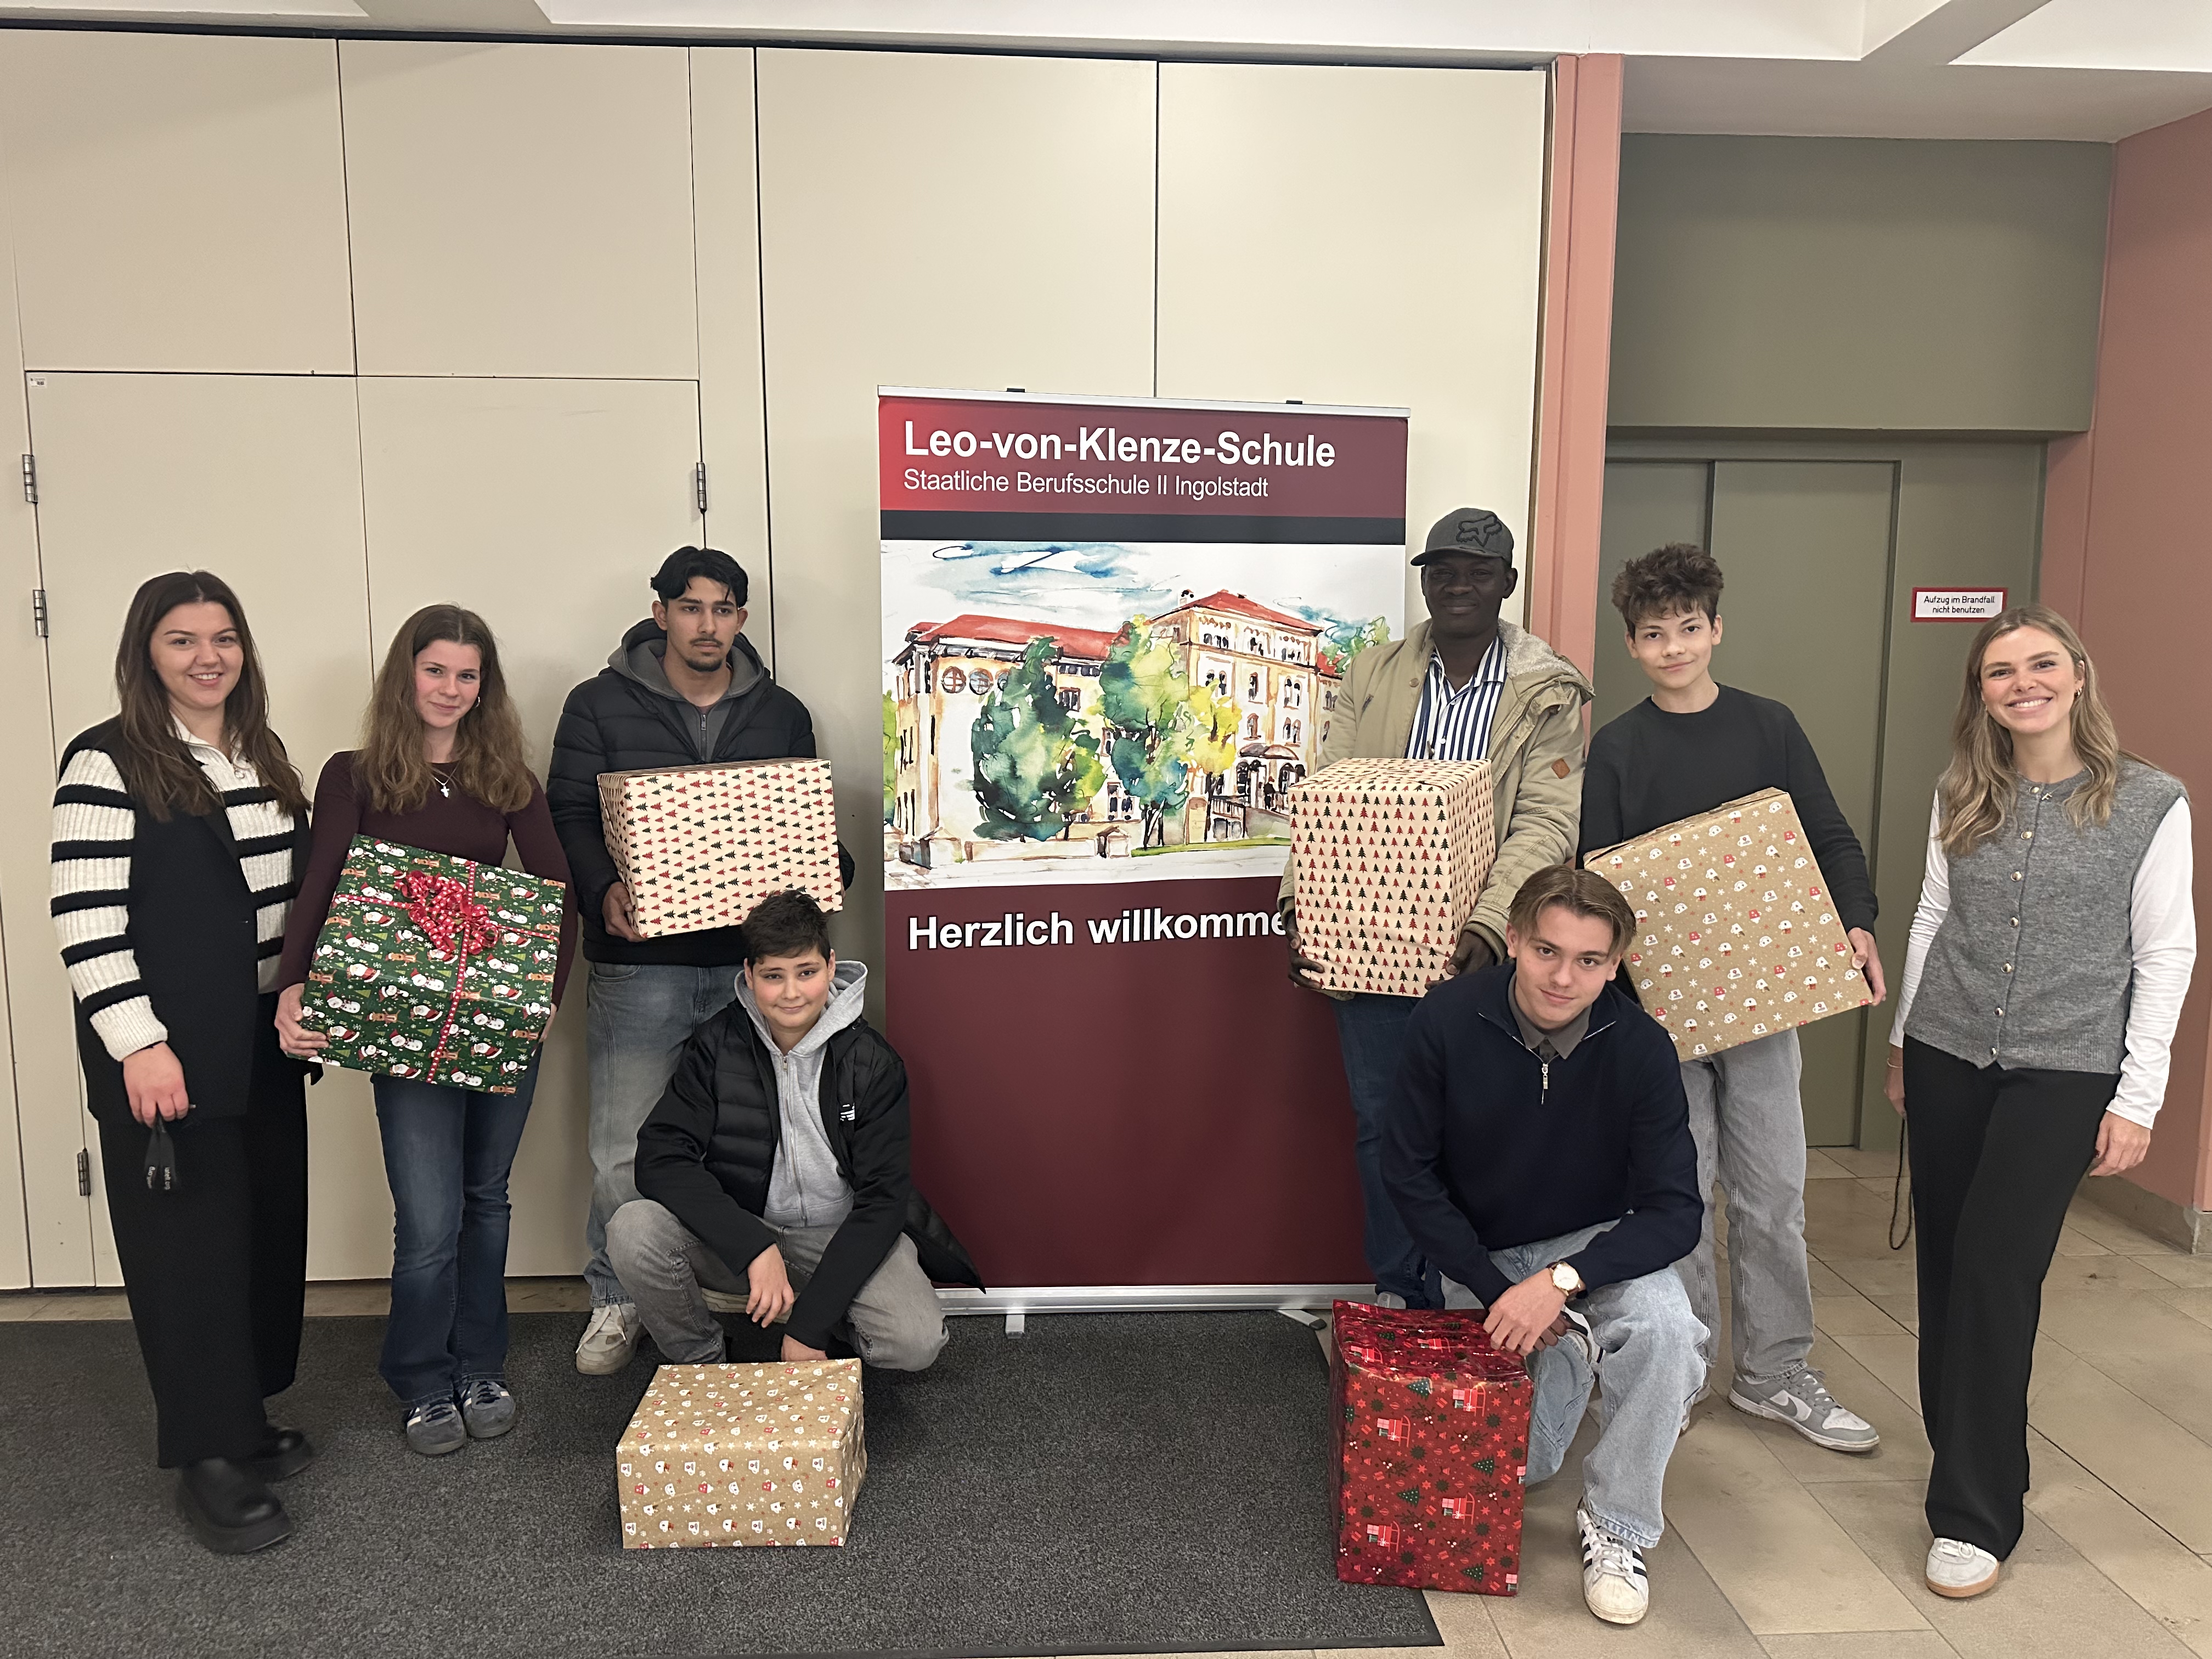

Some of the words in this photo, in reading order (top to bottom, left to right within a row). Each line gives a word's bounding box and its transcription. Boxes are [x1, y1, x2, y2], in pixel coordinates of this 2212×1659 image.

[905, 420, 1336, 467] Leo-von-Klenze-Schule
[904, 467, 1009, 492] Staatliche
[1017, 471, 1150, 495] Berufsschule
[1157, 474, 1167, 495] II
[1175, 475, 1269, 501] Ingolstadt
[1923, 595, 1950, 605] Aufzug
[1951, 595, 1960, 603] im
[1961, 595, 1995, 603] Brandfall
[1932, 605, 1950, 613] nicht
[1951, 605, 1985, 613] benutzen
[909, 911, 1074, 950] Herzlich
[1087, 907, 1286, 944] willkomme
